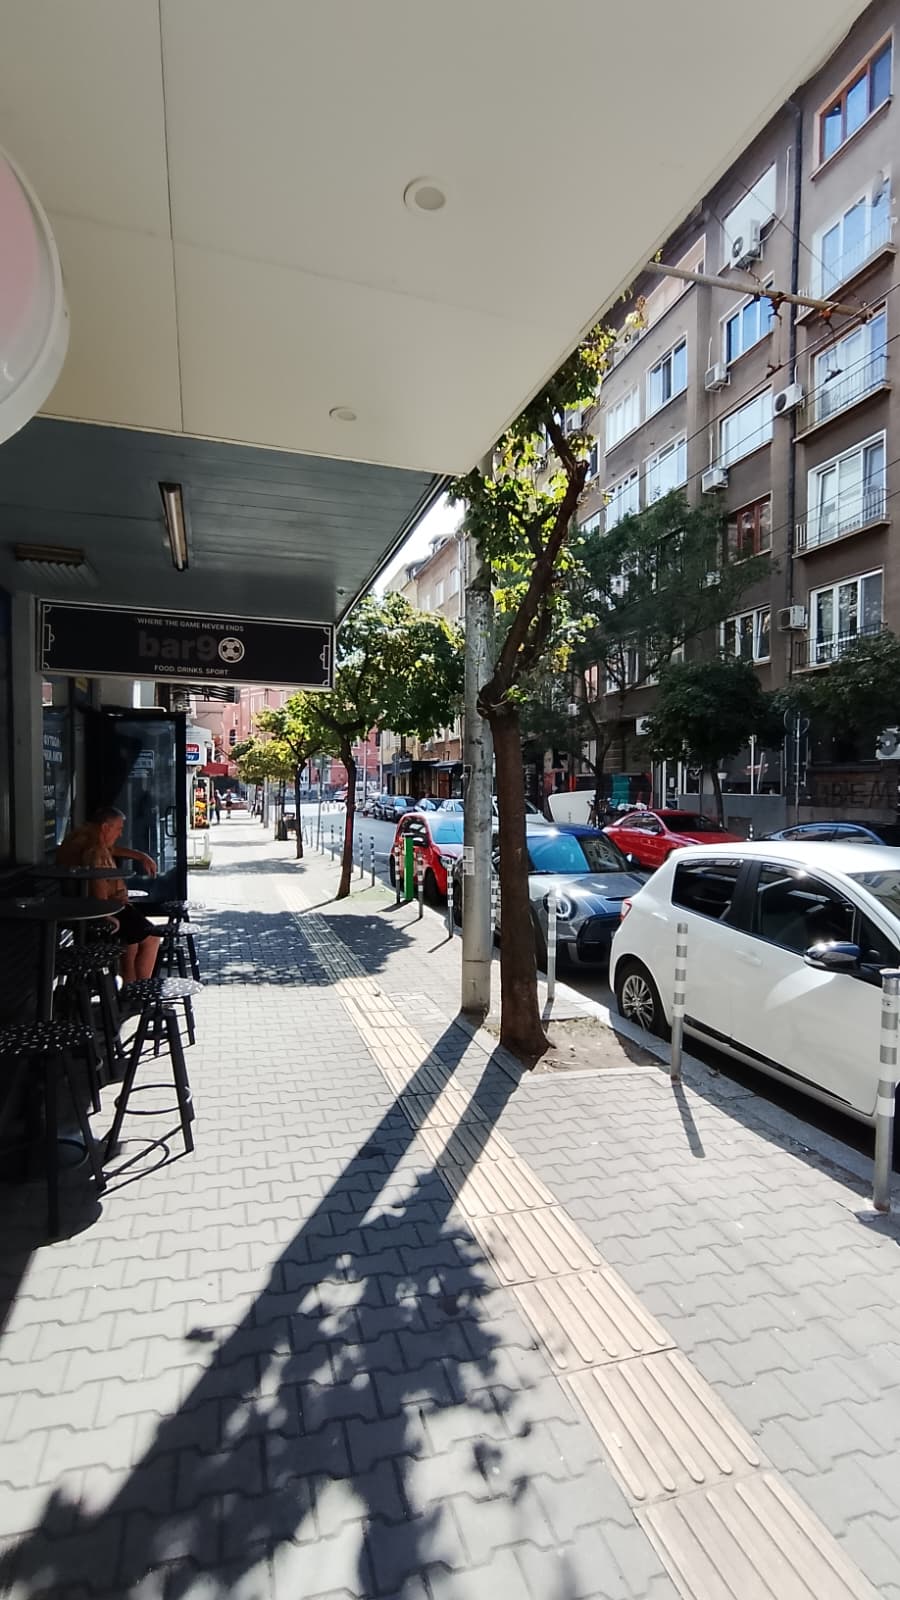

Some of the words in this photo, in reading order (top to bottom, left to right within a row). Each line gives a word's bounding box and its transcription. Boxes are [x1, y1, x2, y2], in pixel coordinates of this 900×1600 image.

[137, 617, 162, 626] WHERE
[180, 621, 201, 629] GAME
[201, 623, 225, 631] NEVER
[225, 624, 244, 632] ENDS
[205, 668, 228, 676] SPORT
